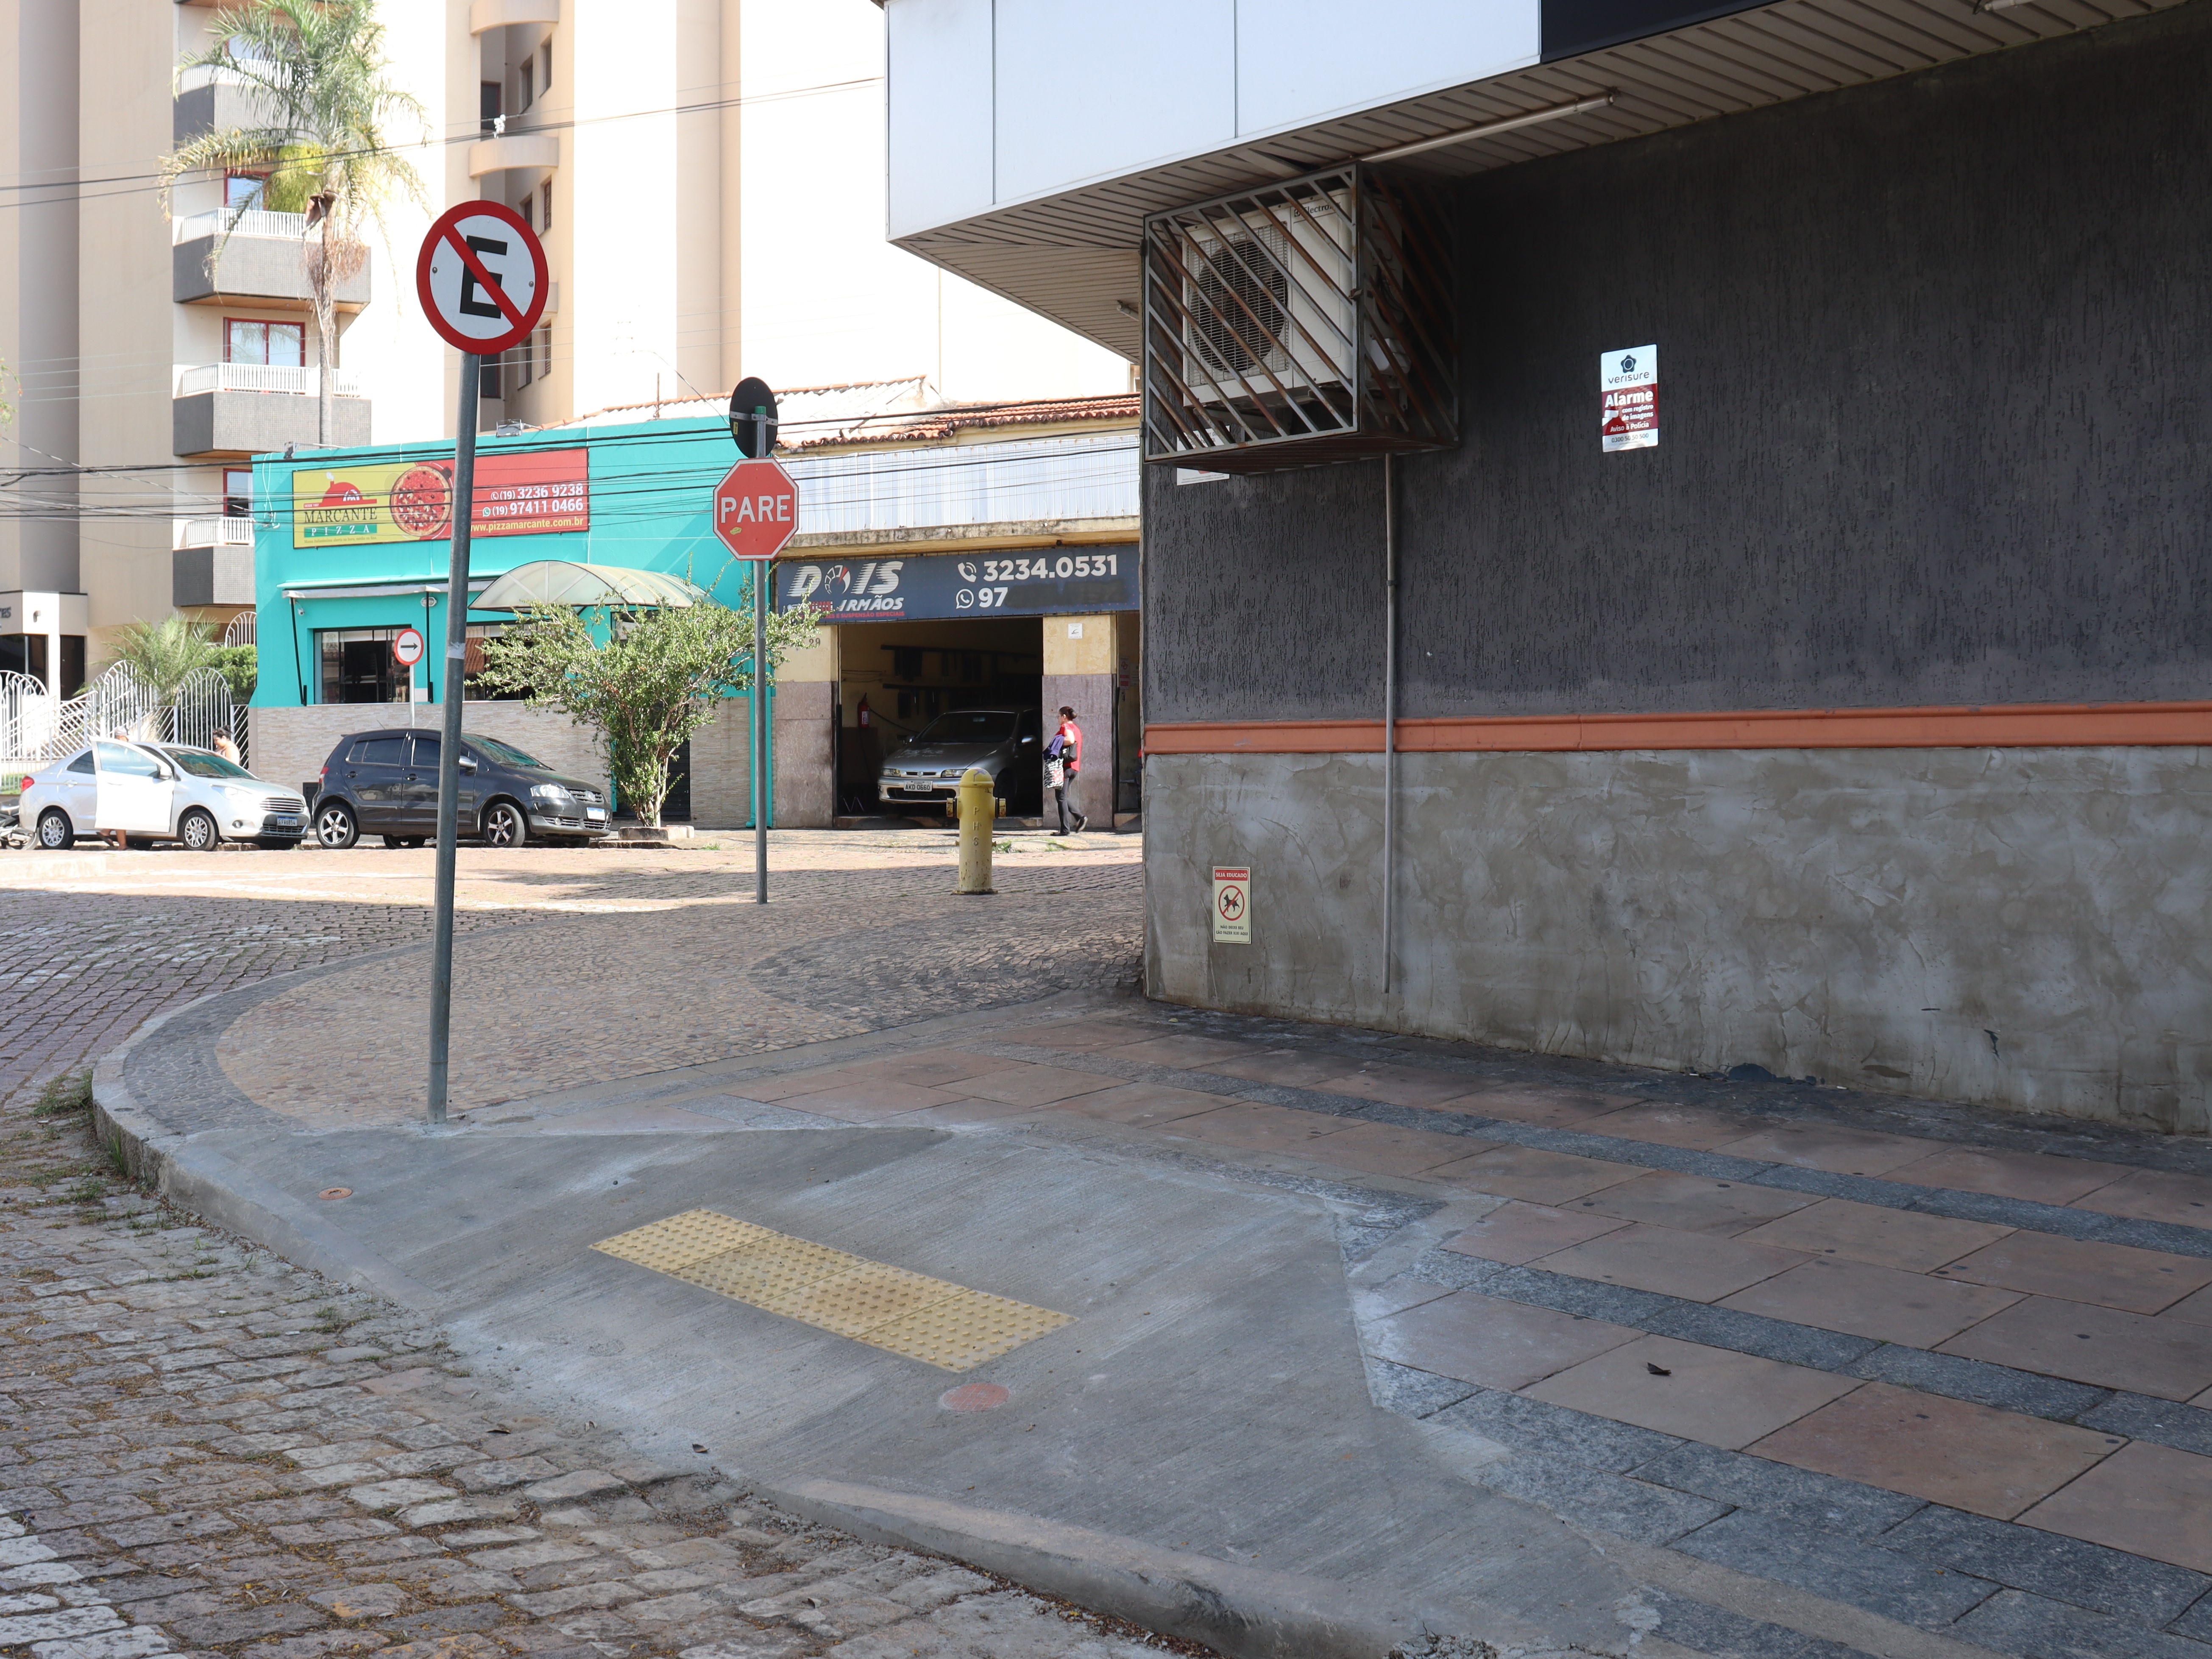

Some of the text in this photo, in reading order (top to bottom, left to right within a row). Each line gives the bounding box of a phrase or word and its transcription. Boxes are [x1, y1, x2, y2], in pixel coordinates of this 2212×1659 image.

[460, 235, 507, 319] E
[1608, 371, 1649, 384] verisure
[1605, 390, 1653, 407] Alarme
[1630, 421, 1649, 429] Polícia
[500, 483, 583, 500] (19) 3236 9238
[304, 508, 377, 523] MARCANTE
[492, 498, 583, 516] (19) 97411 0466
[721, 495, 791, 523] PARE
[312, 525, 369, 536] PIZZA
[471, 516, 583, 533] ww.pizzamarcante.com.br
[983, 554, 1117, 582] 3234.0531
[839, 594, 904, 611] IRMÃOS
